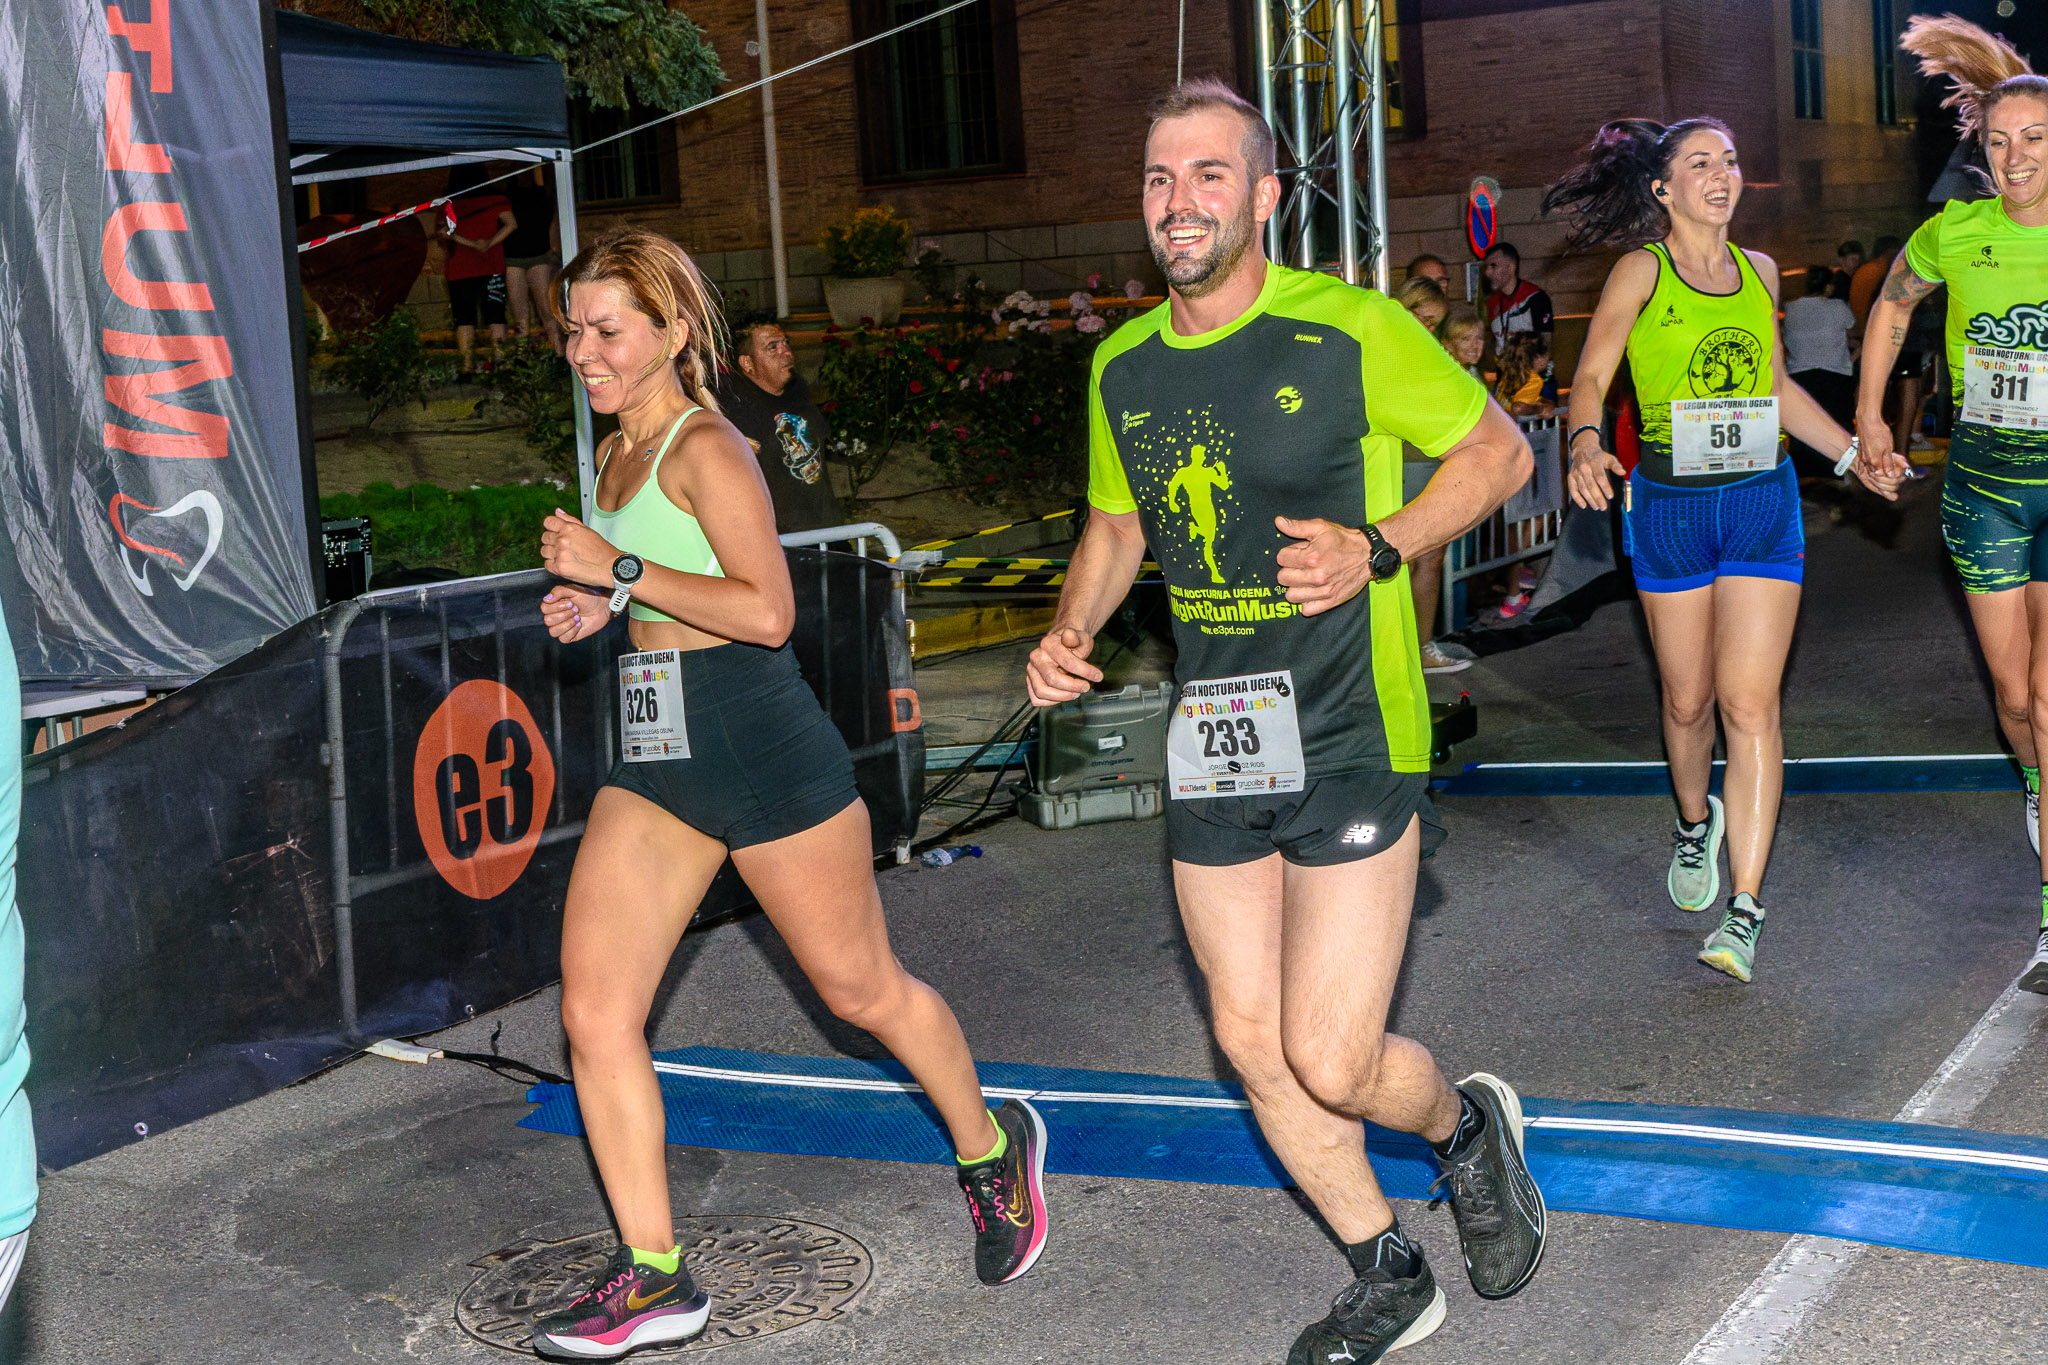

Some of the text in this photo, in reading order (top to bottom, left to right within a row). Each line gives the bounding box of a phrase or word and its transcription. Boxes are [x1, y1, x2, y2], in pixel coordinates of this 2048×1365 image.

[1699, 330, 1759, 357] BROTHERS
[1975, 347, 1995, 356] LEGUA
[1996, 349, 2035, 361] NOCTURNA
[1990, 373, 2029, 402] 311
[1684, 401, 1706, 410] LEGUA
[1708, 400, 1747, 409] NOCTURNA
[1748, 399, 1773, 408] UGENA
[1710, 423, 1741, 449] 58
[1184, 588, 1231, 599] NOCTURNA
[1232, 587, 1271, 598] UGENA
[654, 651, 675, 664] UGENA
[1198, 681, 1248, 698] NOCTURNA
[1251, 676, 1284, 692] UGENA
[626, 686, 659, 725] 326
[1197, 717, 1261, 758] 233
[1208, 763, 1228, 771] JORGE
[1249, 760, 1265, 769] RIOS
[436, 719, 534, 860] e3
